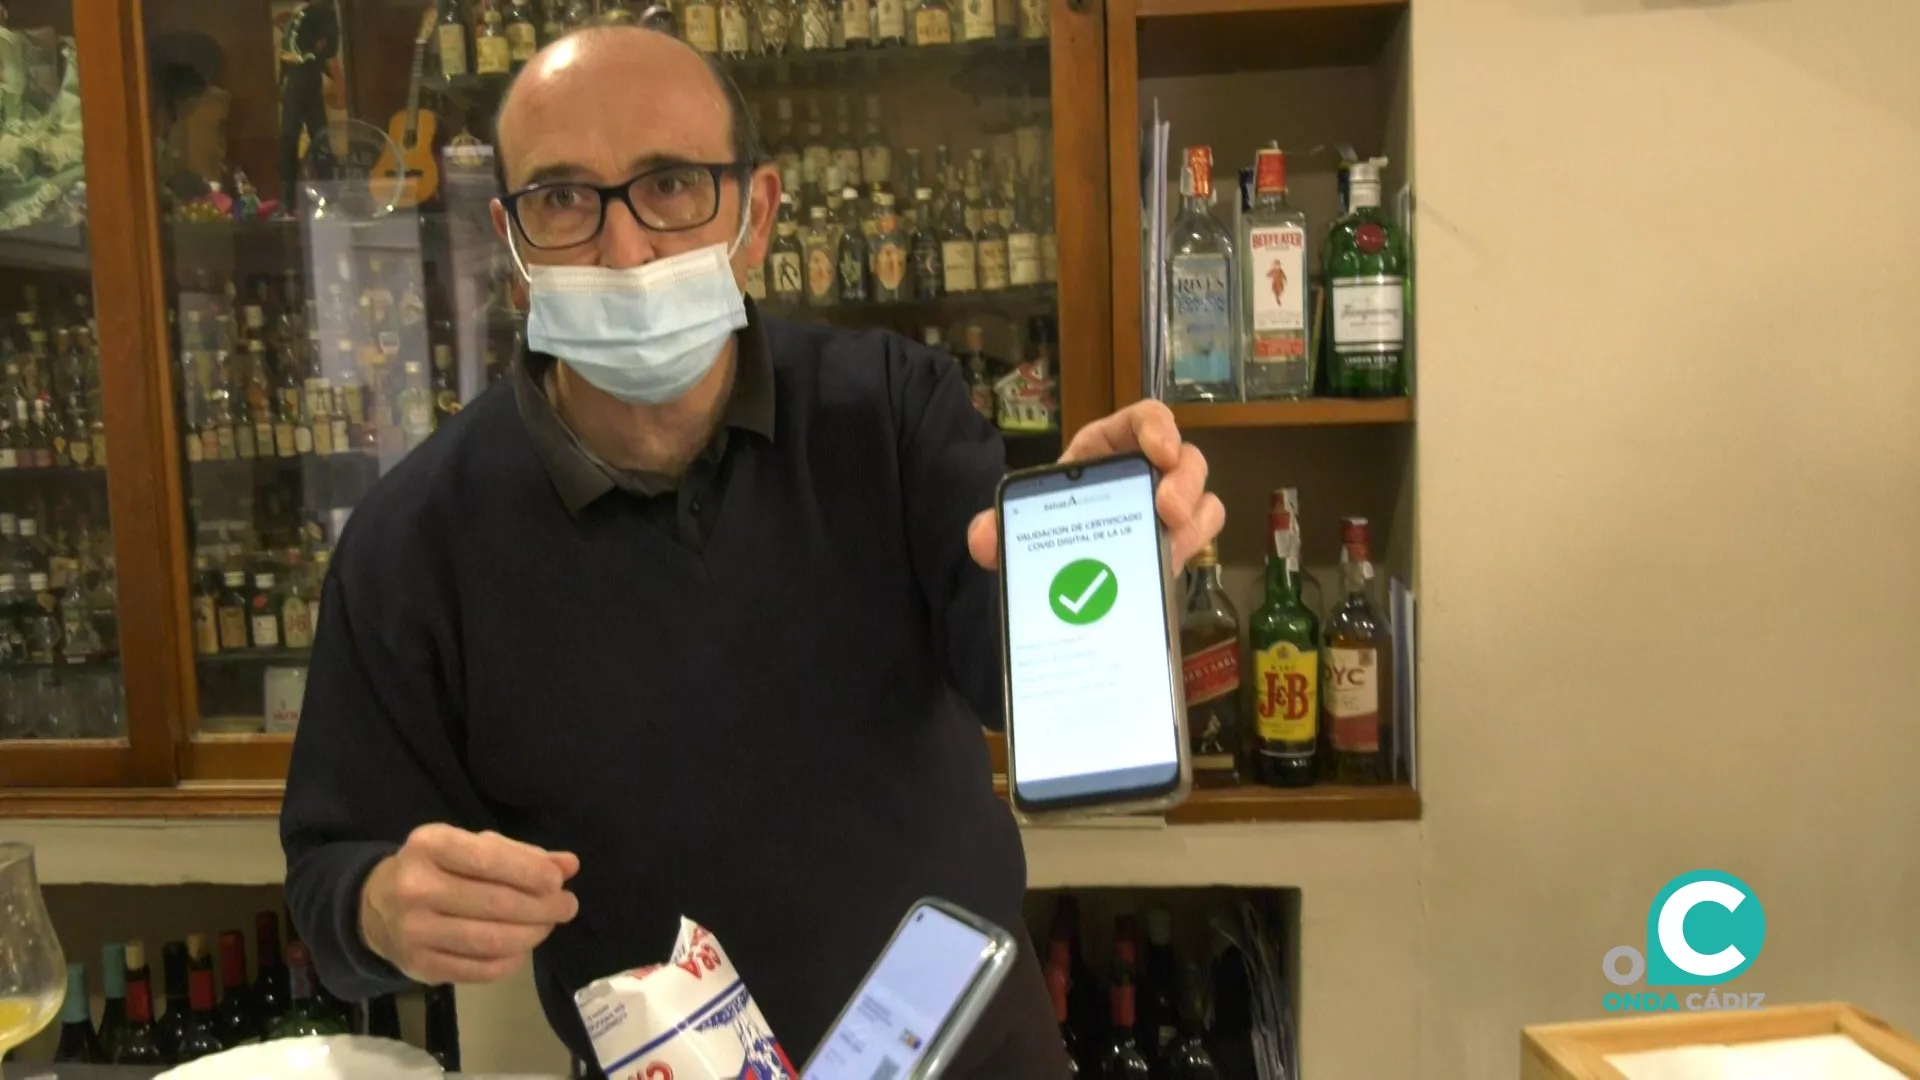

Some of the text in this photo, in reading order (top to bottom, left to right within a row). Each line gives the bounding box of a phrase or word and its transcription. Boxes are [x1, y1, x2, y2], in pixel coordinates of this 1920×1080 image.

[1252, 232, 1302, 249] BEEFEATER
[1085, 511, 1143, 531] CERTIFICADO
[1027, 539, 1056, 553] COVID
[1057, 533, 1091, 548] DIGITAL
[1107, 528, 1119, 539] LA
[1323, 664, 1365, 686] DYC
[1258, 671, 1309, 720] J&B
